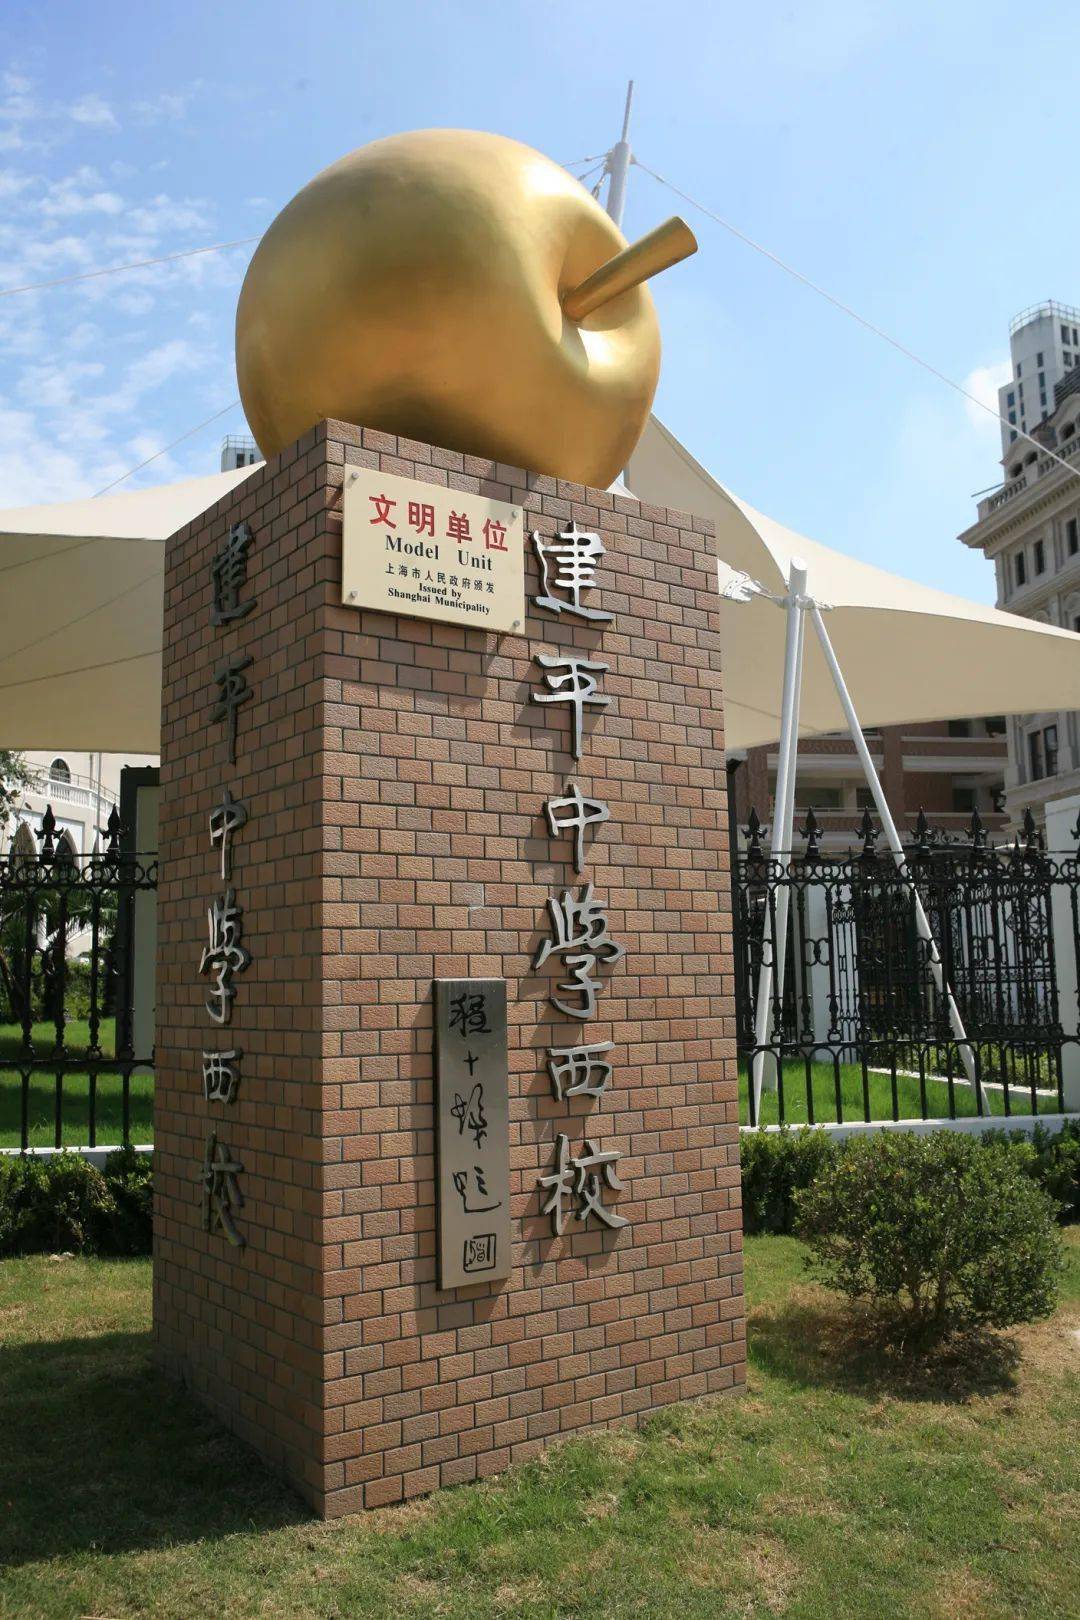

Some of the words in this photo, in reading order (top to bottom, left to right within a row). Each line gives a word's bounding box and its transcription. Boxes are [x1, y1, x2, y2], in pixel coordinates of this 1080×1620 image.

[368, 493, 509, 552] 文明单位
[385, 534, 439, 560] Model
[458, 549, 493, 571] Unit
[385, 562, 495, 594] 上海市人民政府颁发
[419, 582, 447, 596] Issued
[451, 588, 462, 600] by
[387, 587, 431, 603] Shanghai
[434, 596, 491, 615] Municipality
